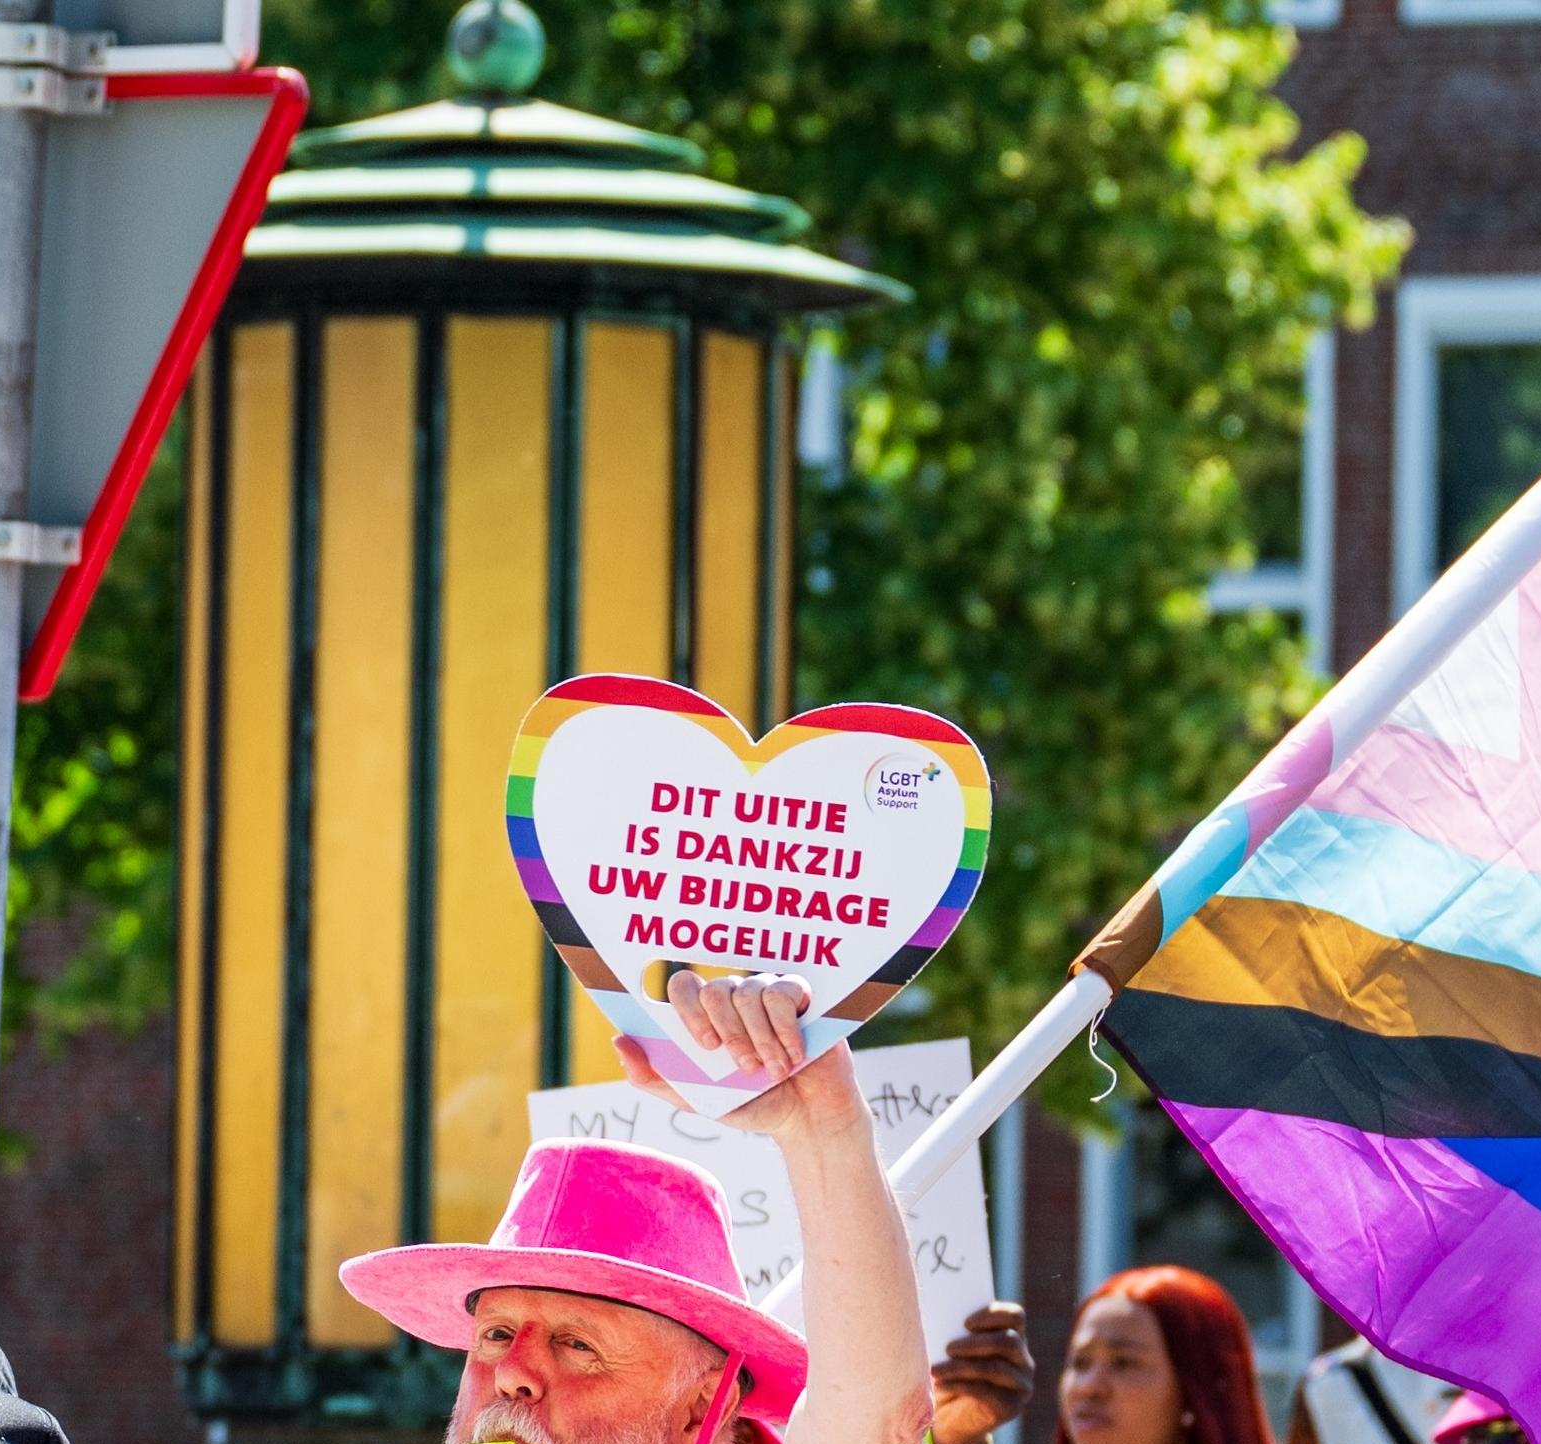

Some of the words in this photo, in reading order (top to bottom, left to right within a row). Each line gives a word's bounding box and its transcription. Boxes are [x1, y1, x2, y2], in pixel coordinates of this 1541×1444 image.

[650, 782, 721, 818] DIT
[734, 791, 848, 834] UITJE
[876, 797, 918, 810] Support
[877, 786, 919, 799] Asylum
[624, 823, 661, 857] IS
[675, 829, 863, 881] DANKZIJ
[587, 863, 668, 902] UW
[678, 874, 890, 931] BIJDRAGE
[624, 912, 842, 968] MOGELIJK
[570, 1101, 640, 1143] MY
